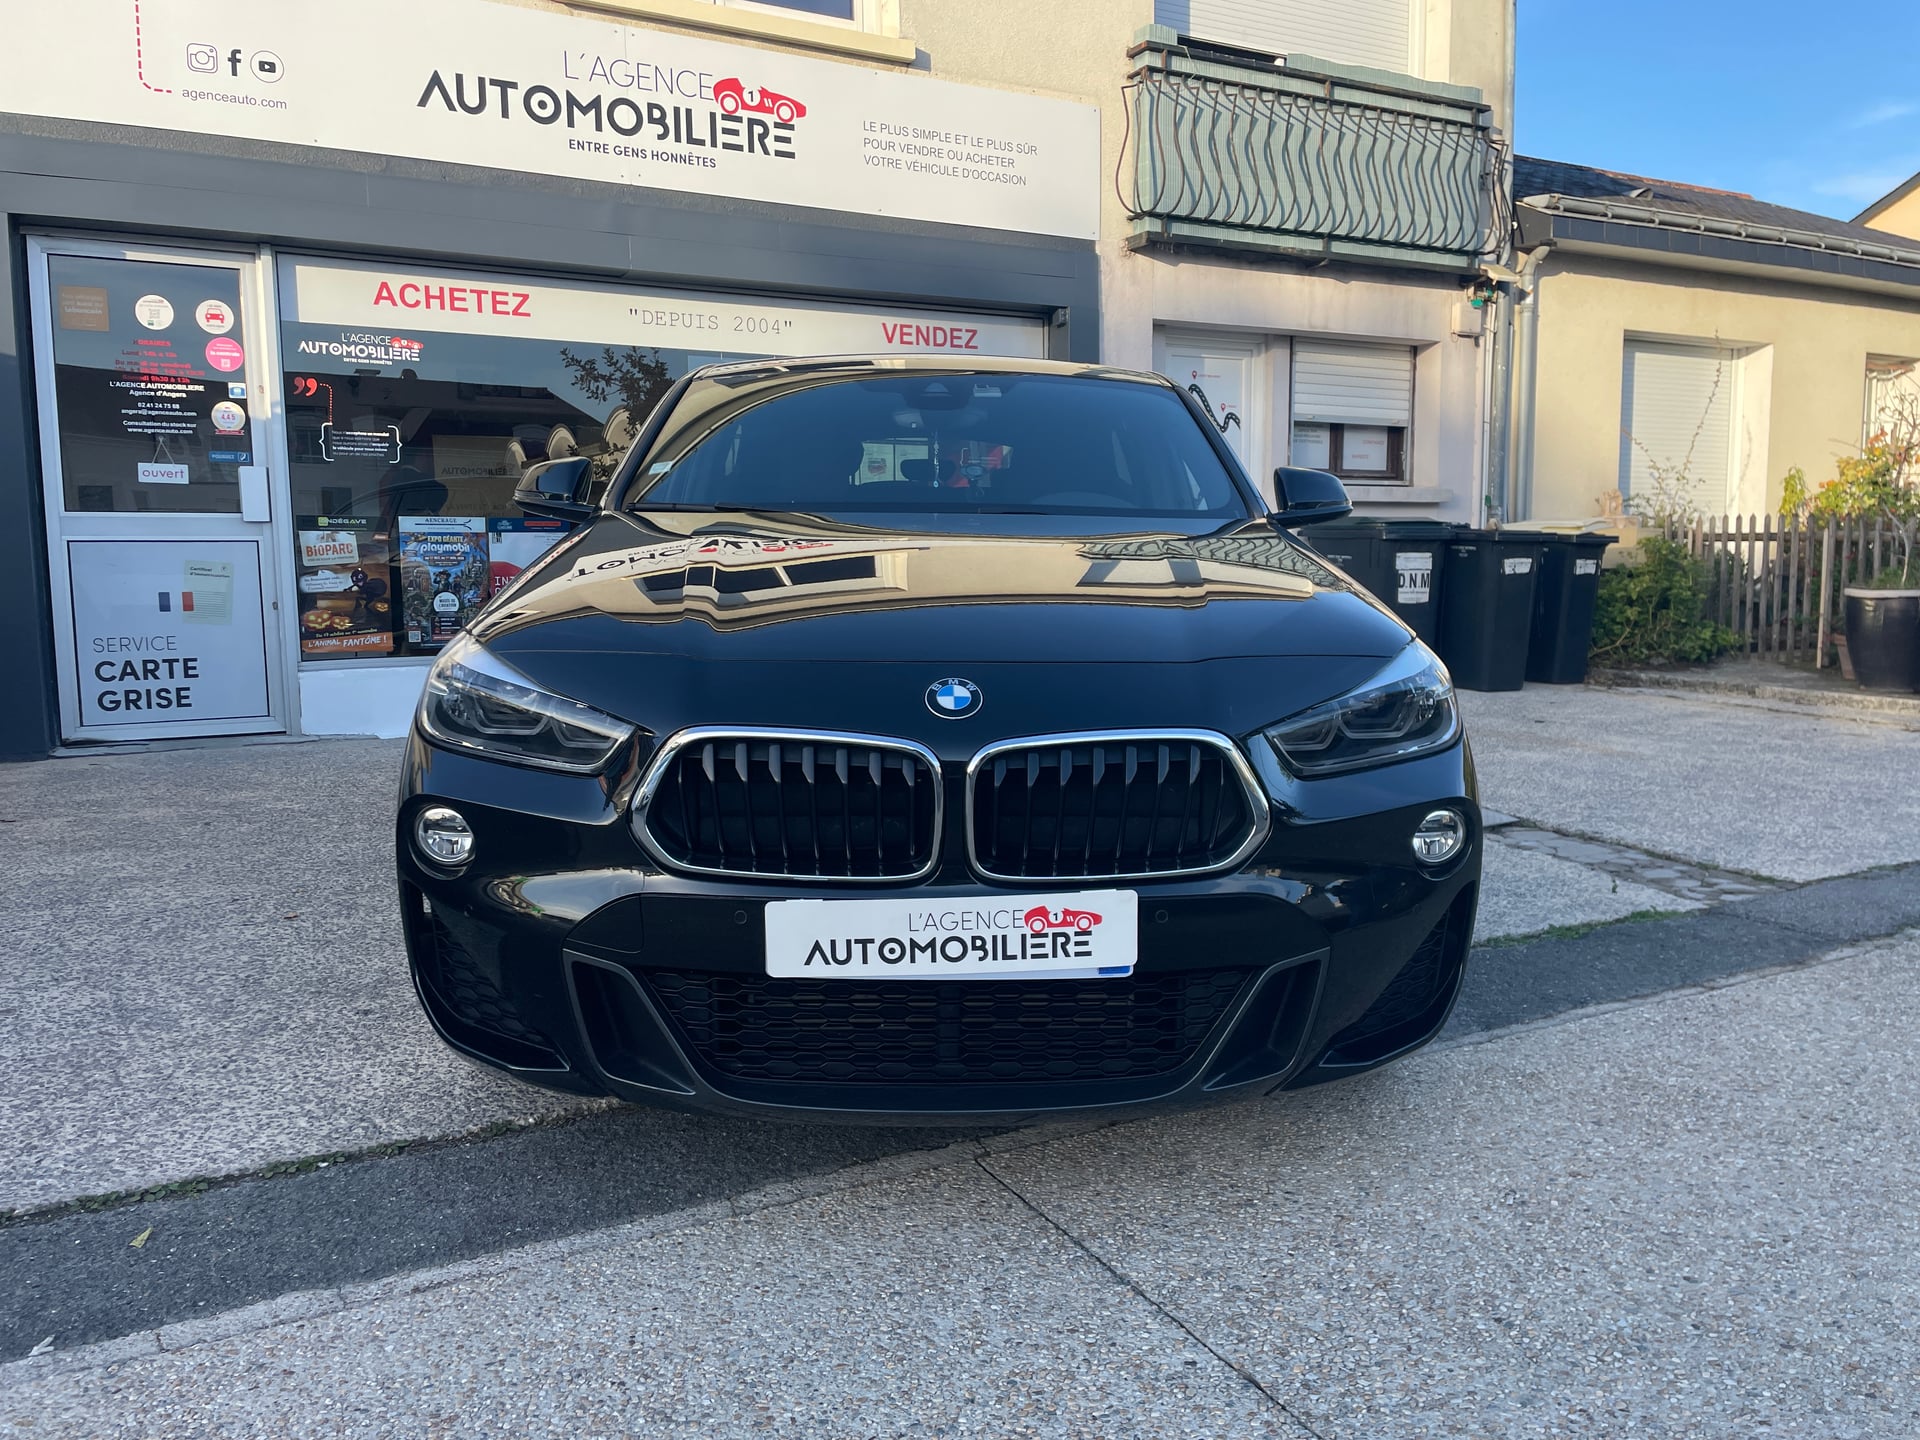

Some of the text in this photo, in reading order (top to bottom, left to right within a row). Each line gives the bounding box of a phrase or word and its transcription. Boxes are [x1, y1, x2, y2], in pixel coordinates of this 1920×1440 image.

[563, 50, 714, 102] L'AGENCE
[182, 88, 287, 110] agenceauto.com
[863, 120, 1038, 156] LE PLUS SIMPLE ET LE PLUS SÛR
[568, 138, 717, 168] ENTRE GENS HONNÊTES
[863, 138, 1016, 169] POUR VENDRE OU ACHETER
[863, 155, 1027, 186] VOTRE VÉHICULE D'OCCASION
[372, 281, 532, 318] ACHETEZ
[341, 332, 391, 346] L'AGENCE
[881, 322, 979, 350] VENDEZ
[141, 467, 185, 479] ouvert
[420, 542, 470, 554] playmobil
[92, 635, 178, 653] SERVICE
[94, 657, 200, 683] CARTE
[931, 679, 977, 692] BMW
[97, 686, 193, 712] GRISE
[908, 909, 1025, 932] L'AGENCE
